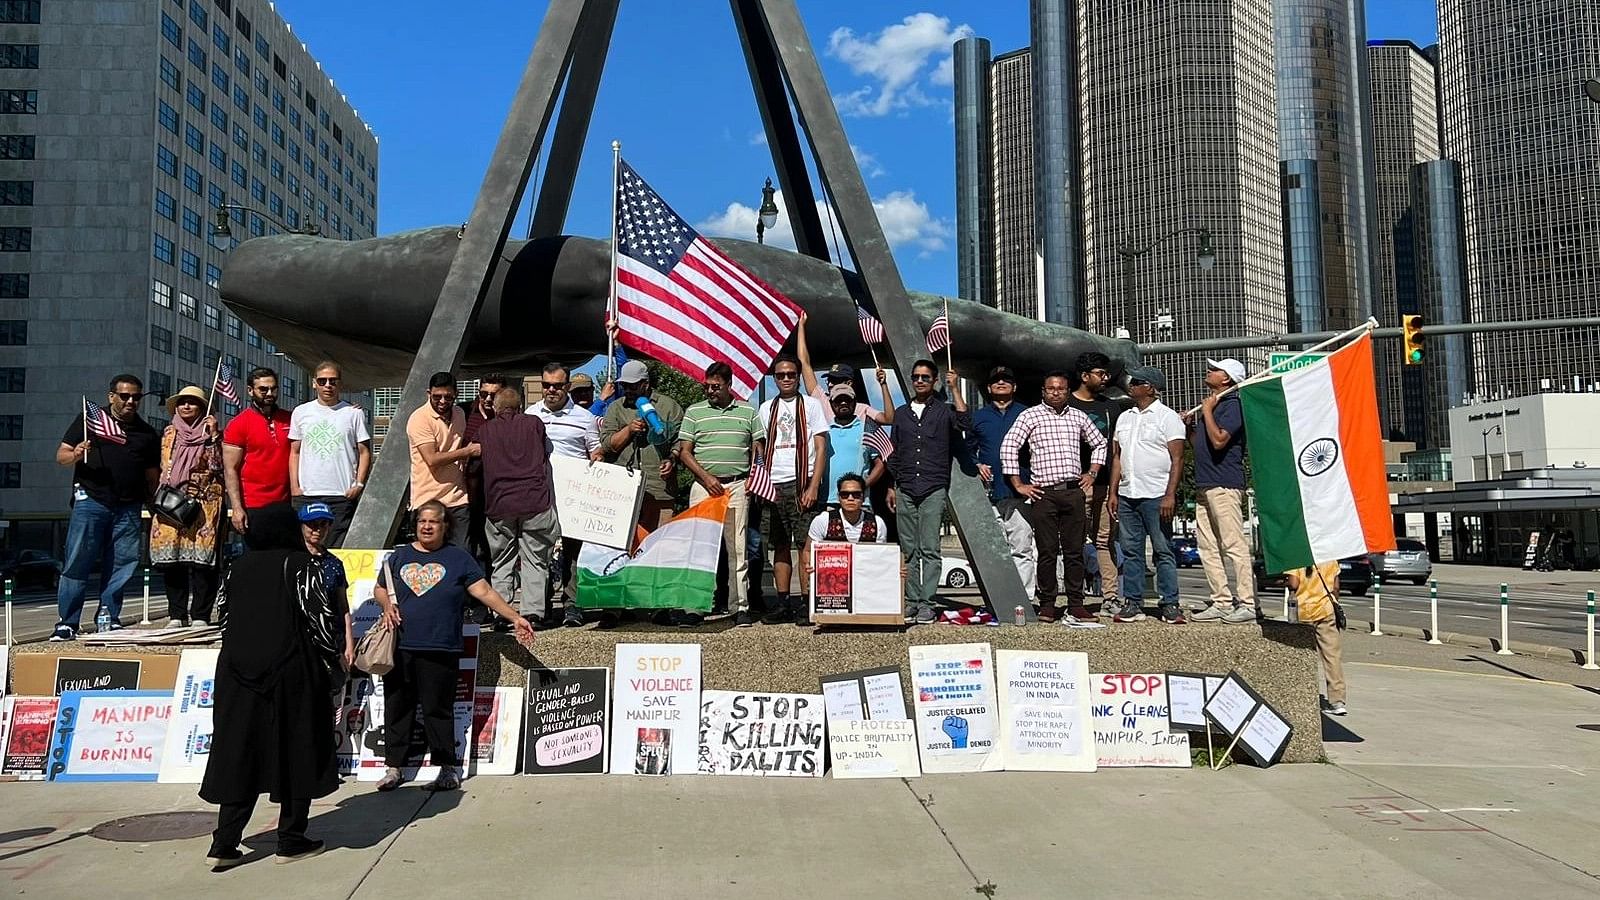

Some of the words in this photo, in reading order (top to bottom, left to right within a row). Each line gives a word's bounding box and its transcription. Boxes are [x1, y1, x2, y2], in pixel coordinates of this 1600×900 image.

[584, 466, 610, 478] STOP
[584, 518, 614, 533] INDIA
[636, 657, 682, 672] STOP
[1024, 661, 1058, 669] PROTECT
[1020, 671, 1063, 680] CHURCHES,
[57, 678, 92, 696] SEXUAL
[93, 675, 111, 688] AND
[630, 678, 693, 691] VIOLENCE
[920, 684, 982, 693] MINORITIES
[1101, 674, 1162, 696] STOP
[529, 688, 563, 705] SEXUAL
[564, 683, 580, 695] AND
[535, 693, 595, 714] GENDER-BASED
[643, 696, 677, 707] SAVE
[730, 695, 809, 720] STOP
[541, 707, 577, 724] VIOLENCE
[626, 710, 681, 720] MANIPUR
[926, 708, 954, 717] JUSTICE
[955, 707, 986, 715] DELAYED
[1043, 711, 1063, 719] INDIA
[534, 726, 540, 735] IS
[542, 722, 564, 734] BASED
[565, 720, 575, 729] ON
[575, 710, 604, 727] POWER
[851, 720, 908, 730] PROTEST
[1122, 716, 1137, 729] IN
[115, 730, 134, 744] IS
[722, 722, 822, 750] KILLING
[830, 734, 860, 743] POLICE
[864, 734, 913, 743] BRUTALITY
[1152, 731, 1187, 746] INDIA
[51, 707, 75, 781] STOP
[544, 738, 559, 750] NOT
[552, 741, 593, 761] SEXUALITY
[926, 742, 951, 750] JUSTICE
[970, 740, 991, 748] DENIED
[80, 747, 153, 763] BURNING
[730, 750, 816, 773] DALITS
